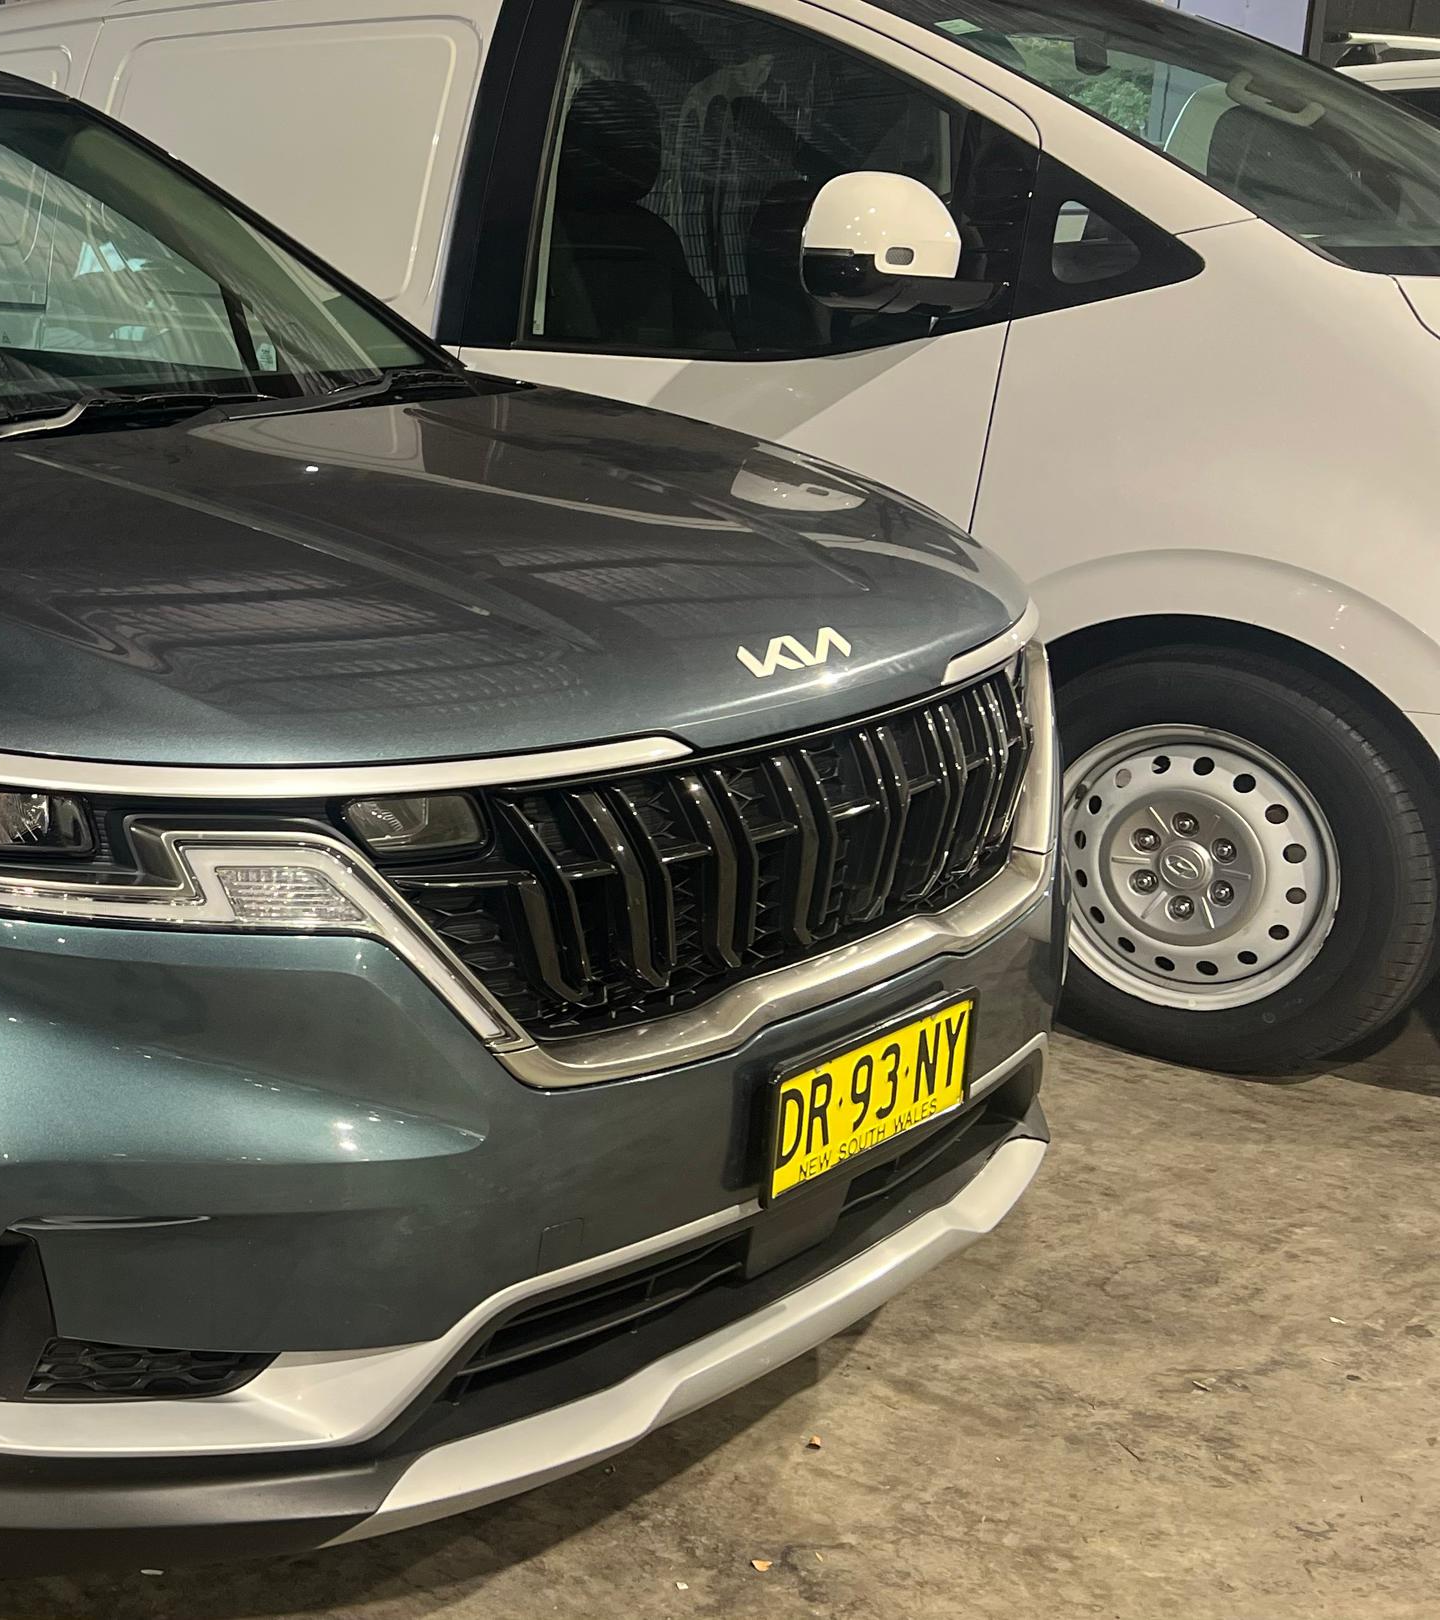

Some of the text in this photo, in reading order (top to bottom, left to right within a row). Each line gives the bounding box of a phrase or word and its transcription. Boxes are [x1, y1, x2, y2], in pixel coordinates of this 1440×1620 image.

[736, 626, 852, 678] KIA
[798, 1097, 938, 1181] NEW SOUTH WALES
